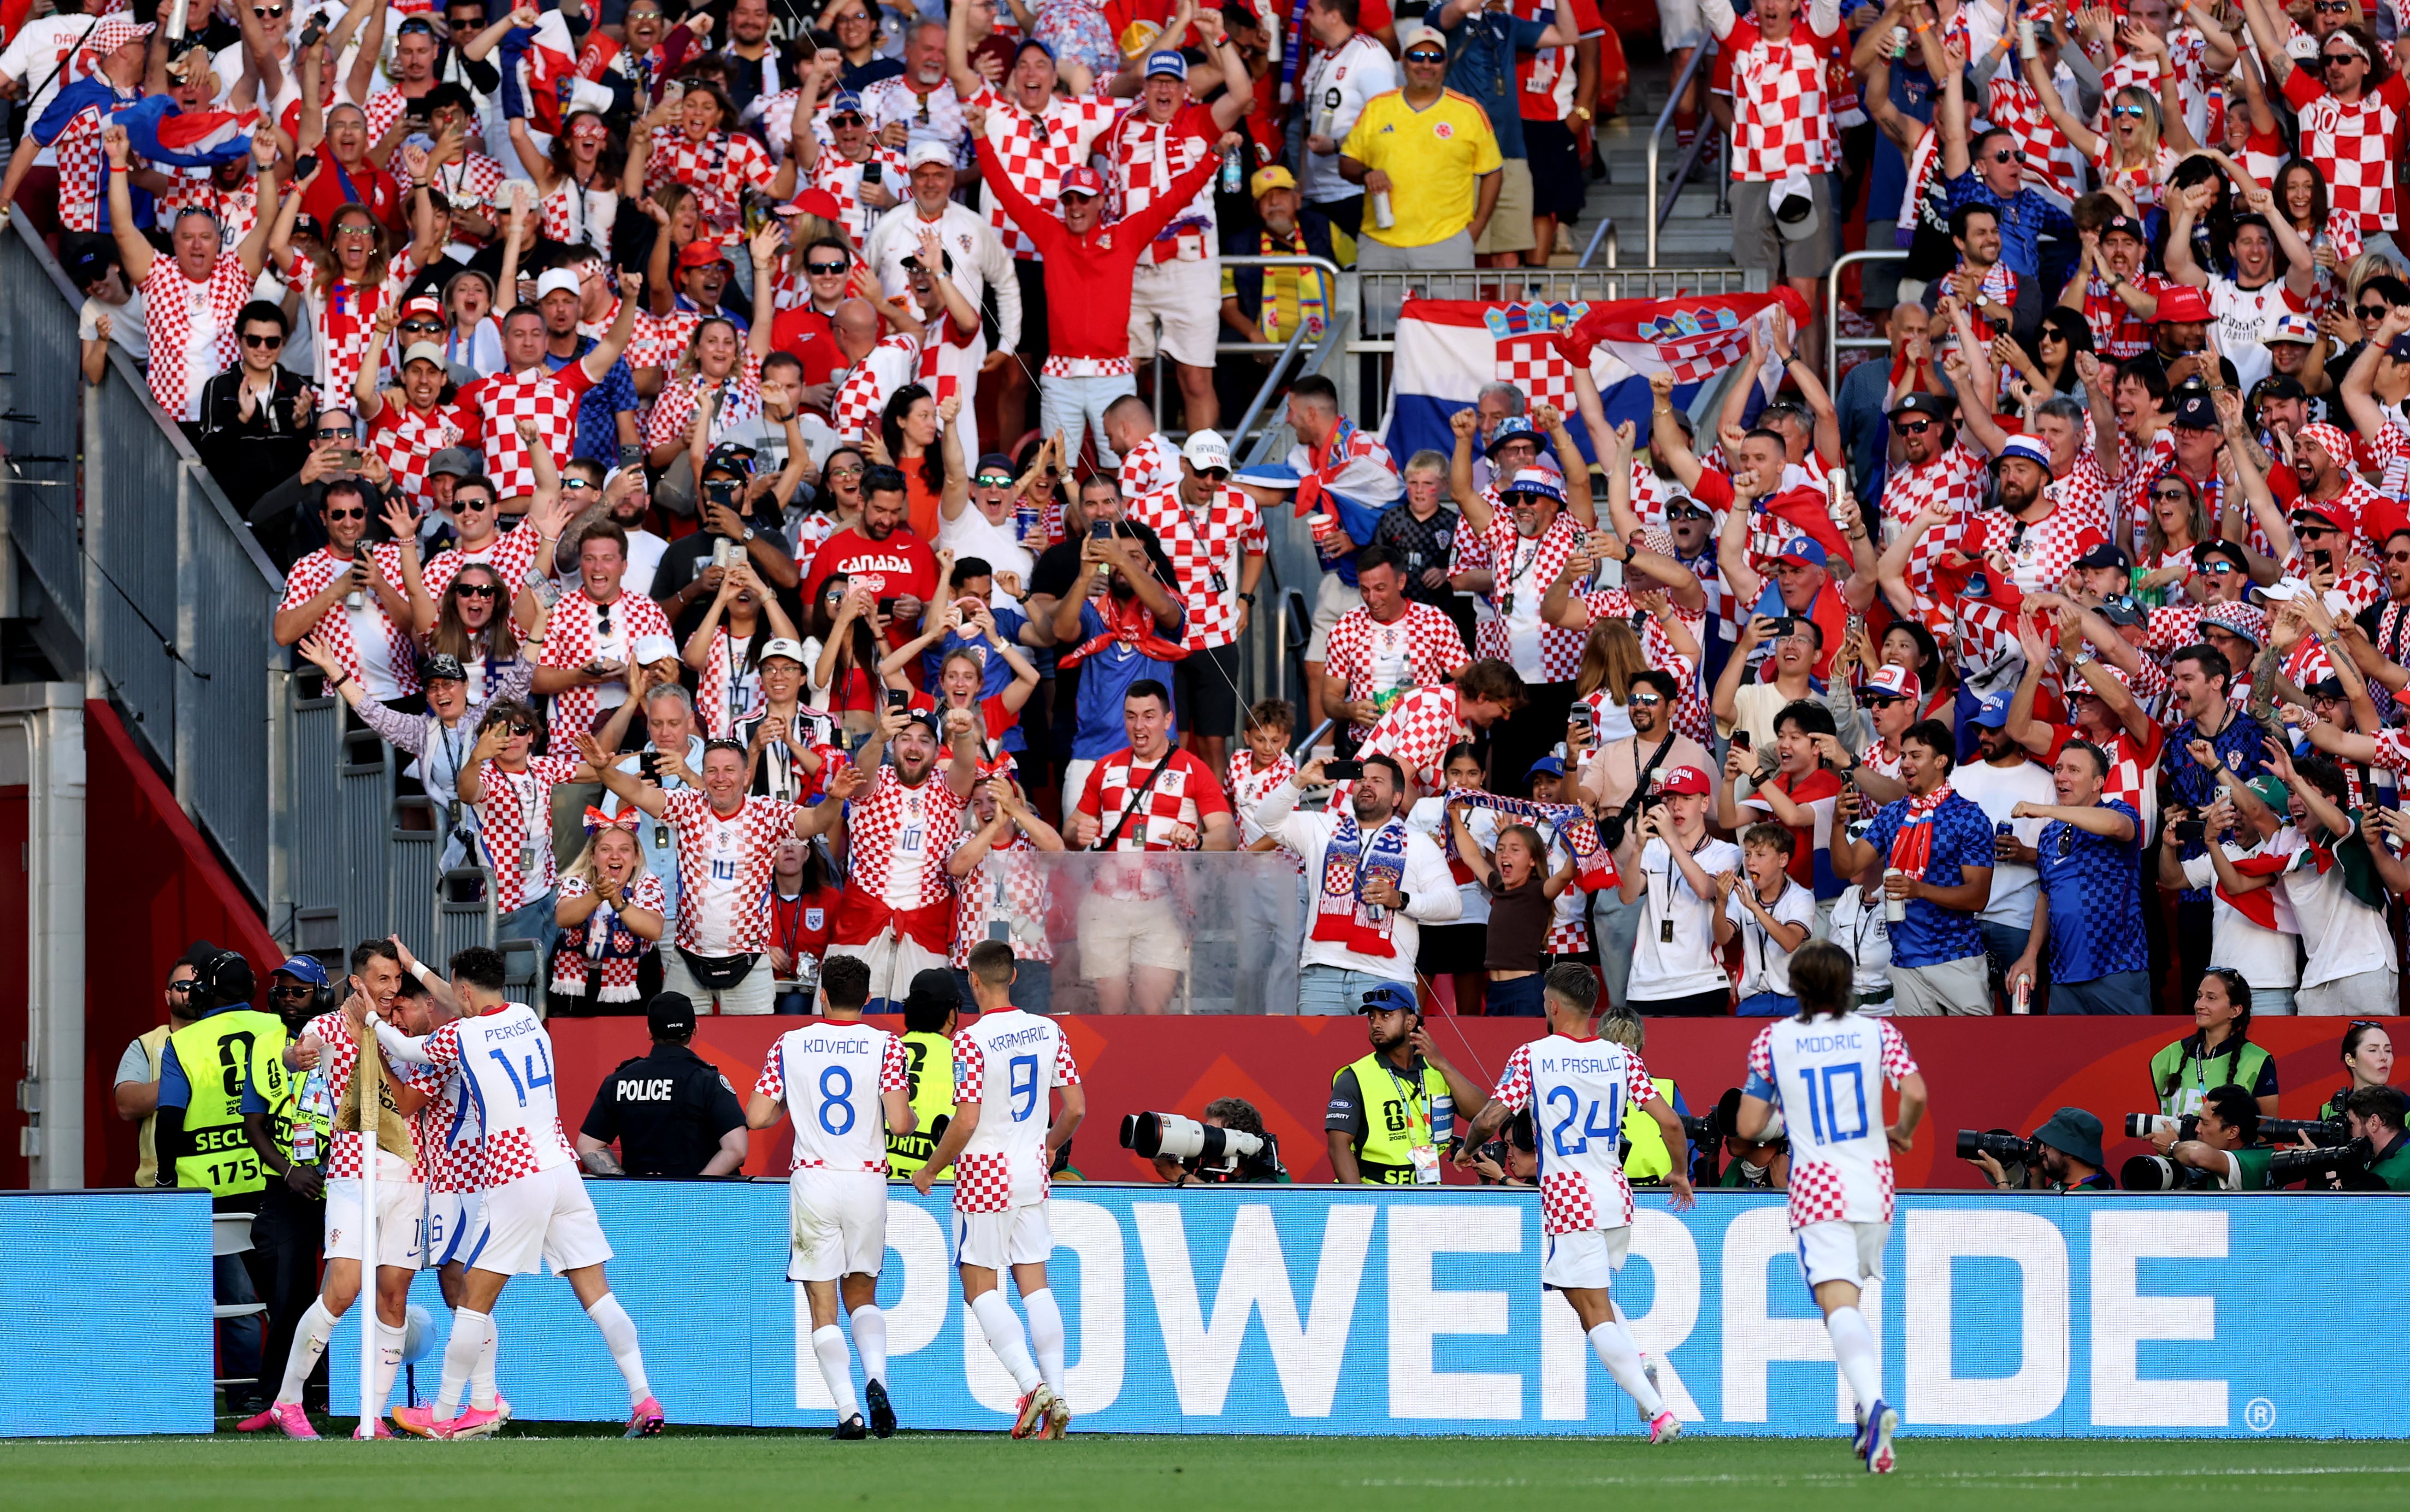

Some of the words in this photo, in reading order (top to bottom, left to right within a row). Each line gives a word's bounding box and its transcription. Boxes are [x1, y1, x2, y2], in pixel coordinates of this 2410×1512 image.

[837, 554, 913, 574] CANADA
[902, 830, 921, 850] 10
[1319, 893, 1356, 916] CROATIA
[804, 1037, 869, 1054] KOVAČIĆ
[1796, 1032, 1862, 1054] MODRIĆ
[488, 1038, 553, 1107] 14
[1542, 1059, 1558, 1072] M.
[617, 1079, 674, 1102] POLICE
[1009, 1054, 1037, 1122] 9
[819, 1065, 855, 1135] 8
[1799, 1062, 1868, 1146] 10
[1547, 1083, 1620, 1156] 24
[196, 1129, 247, 1151] SECU
[207, 1158, 263, 1186] 175
[795, 1201, 2228, 1426] POWERADE
